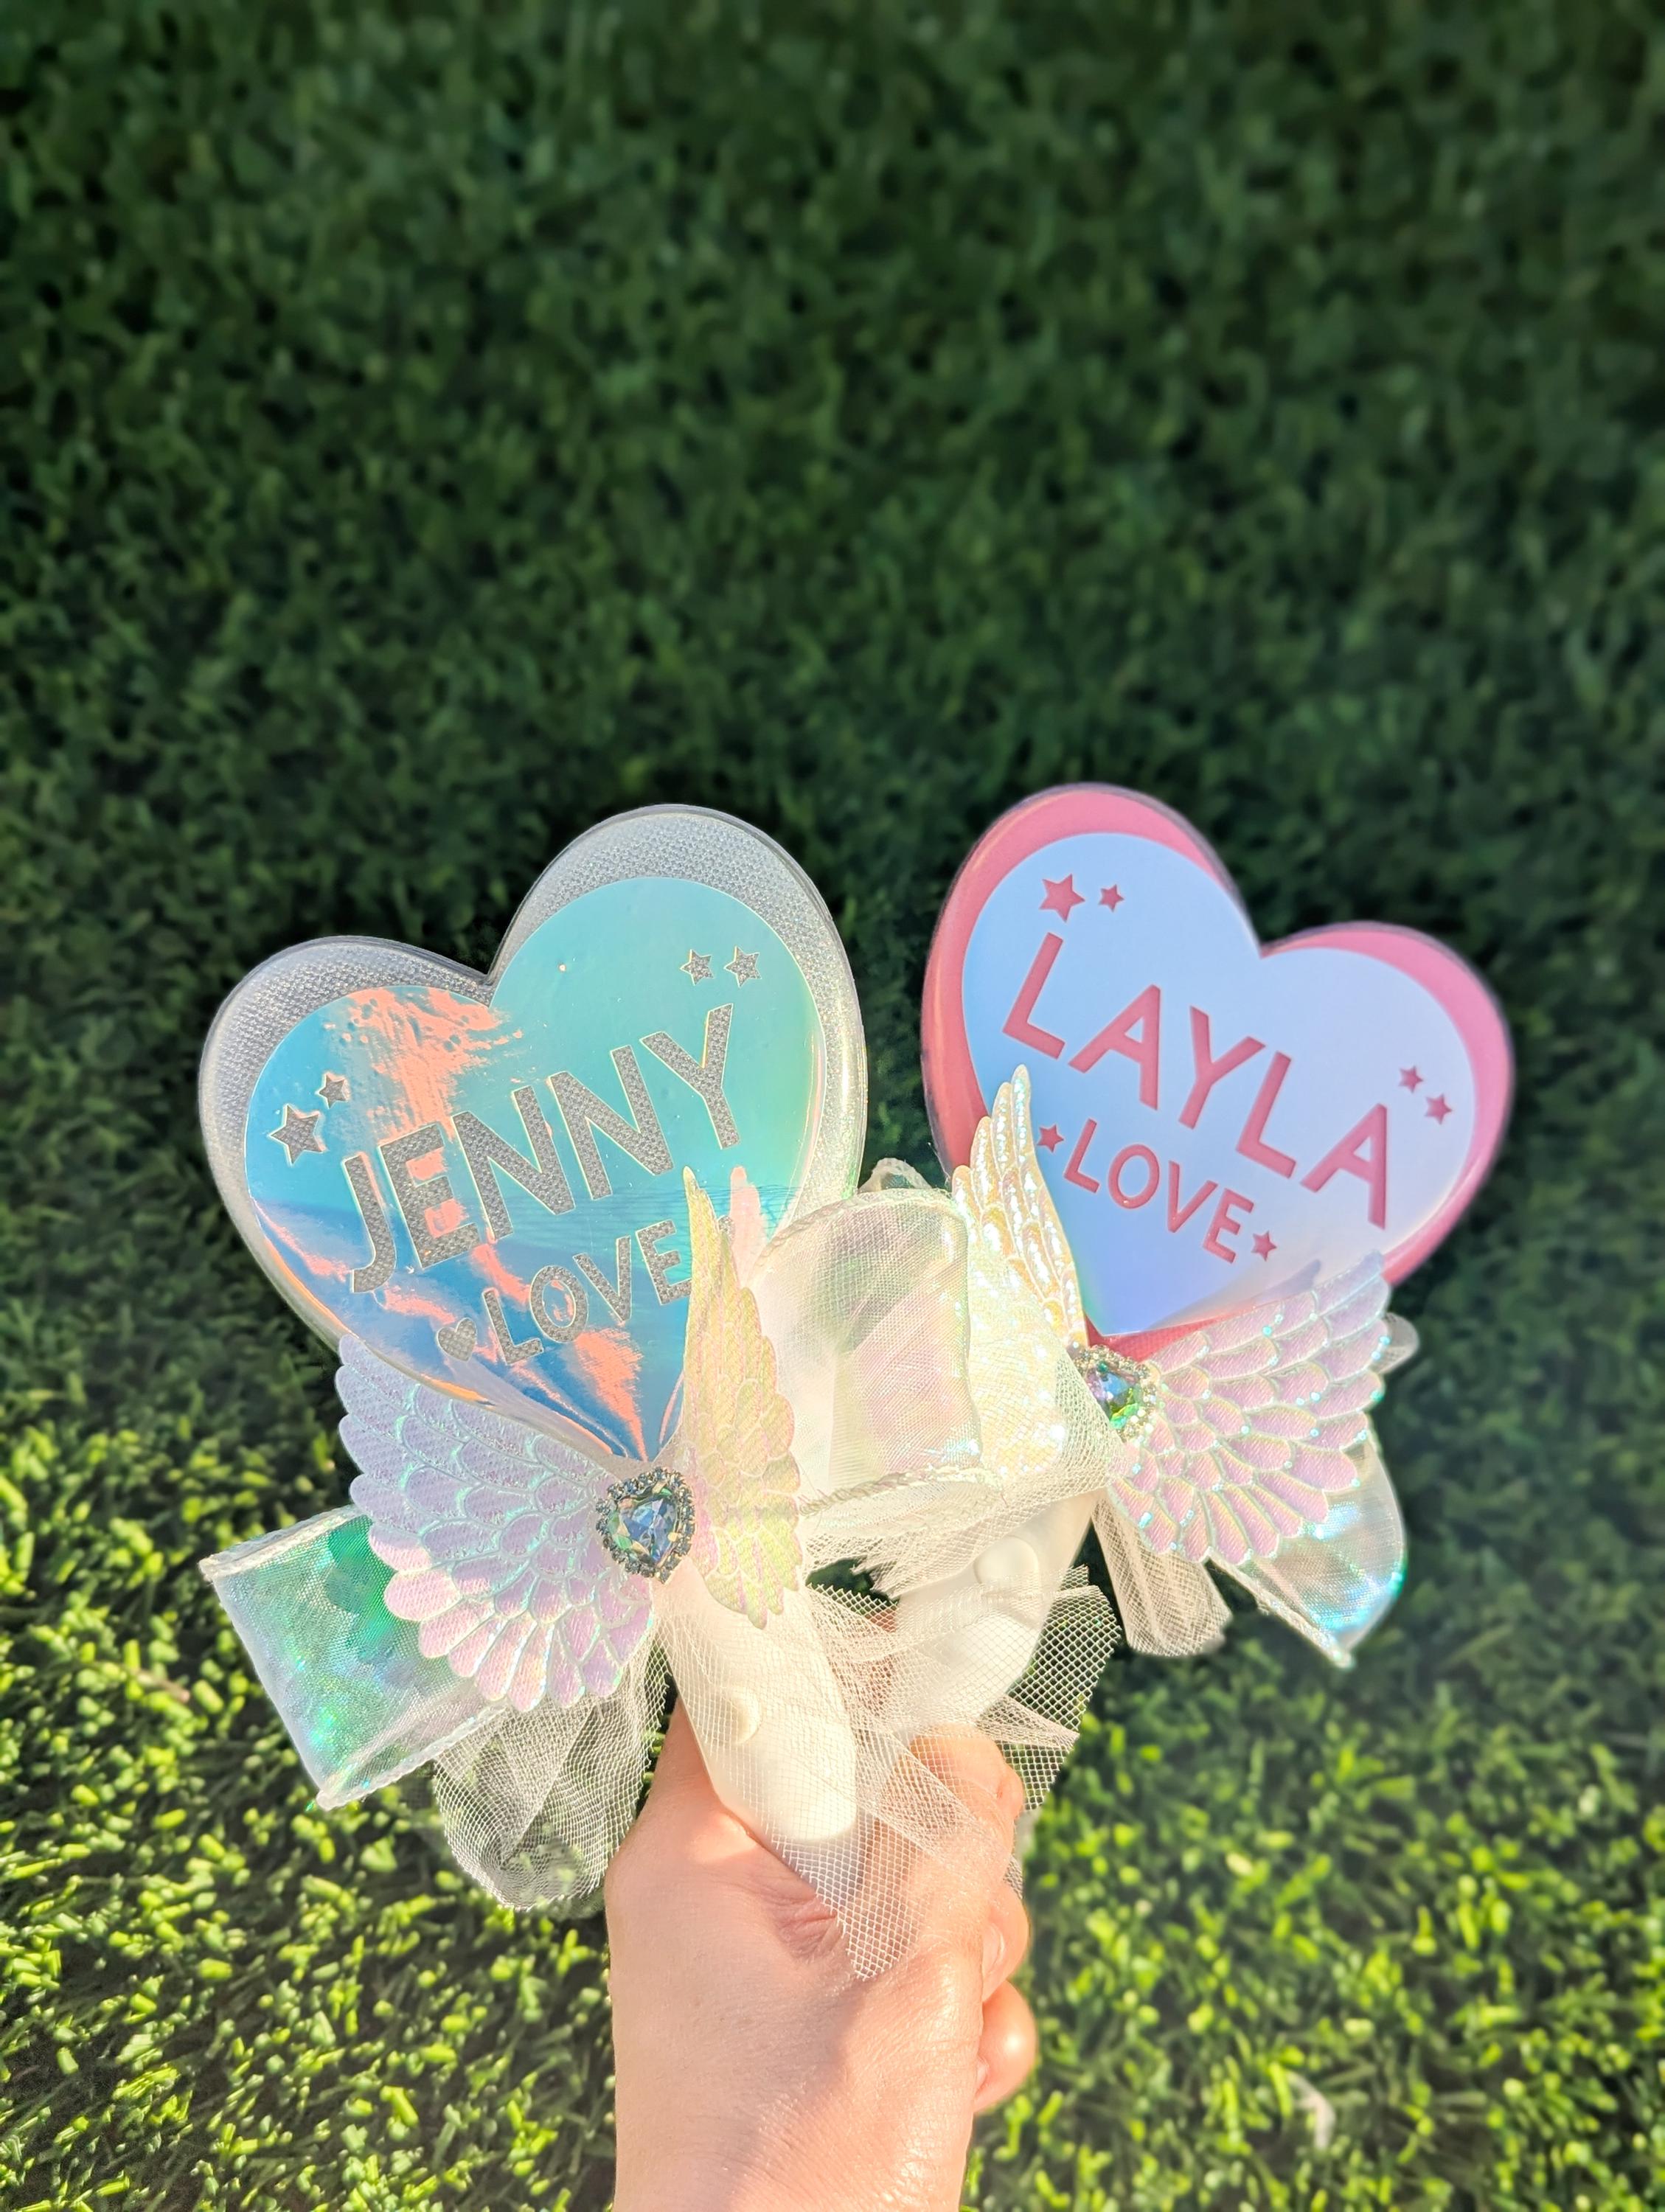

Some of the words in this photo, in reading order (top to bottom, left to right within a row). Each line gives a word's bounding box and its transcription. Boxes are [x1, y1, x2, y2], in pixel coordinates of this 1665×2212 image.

[342, 1003, 740, 1293] JENNY
[1002, 931, 1388, 1230] LAYLA
[483, 1220, 692, 1366] LOVE
[1063, 1119, 1254, 1264] LOVE
